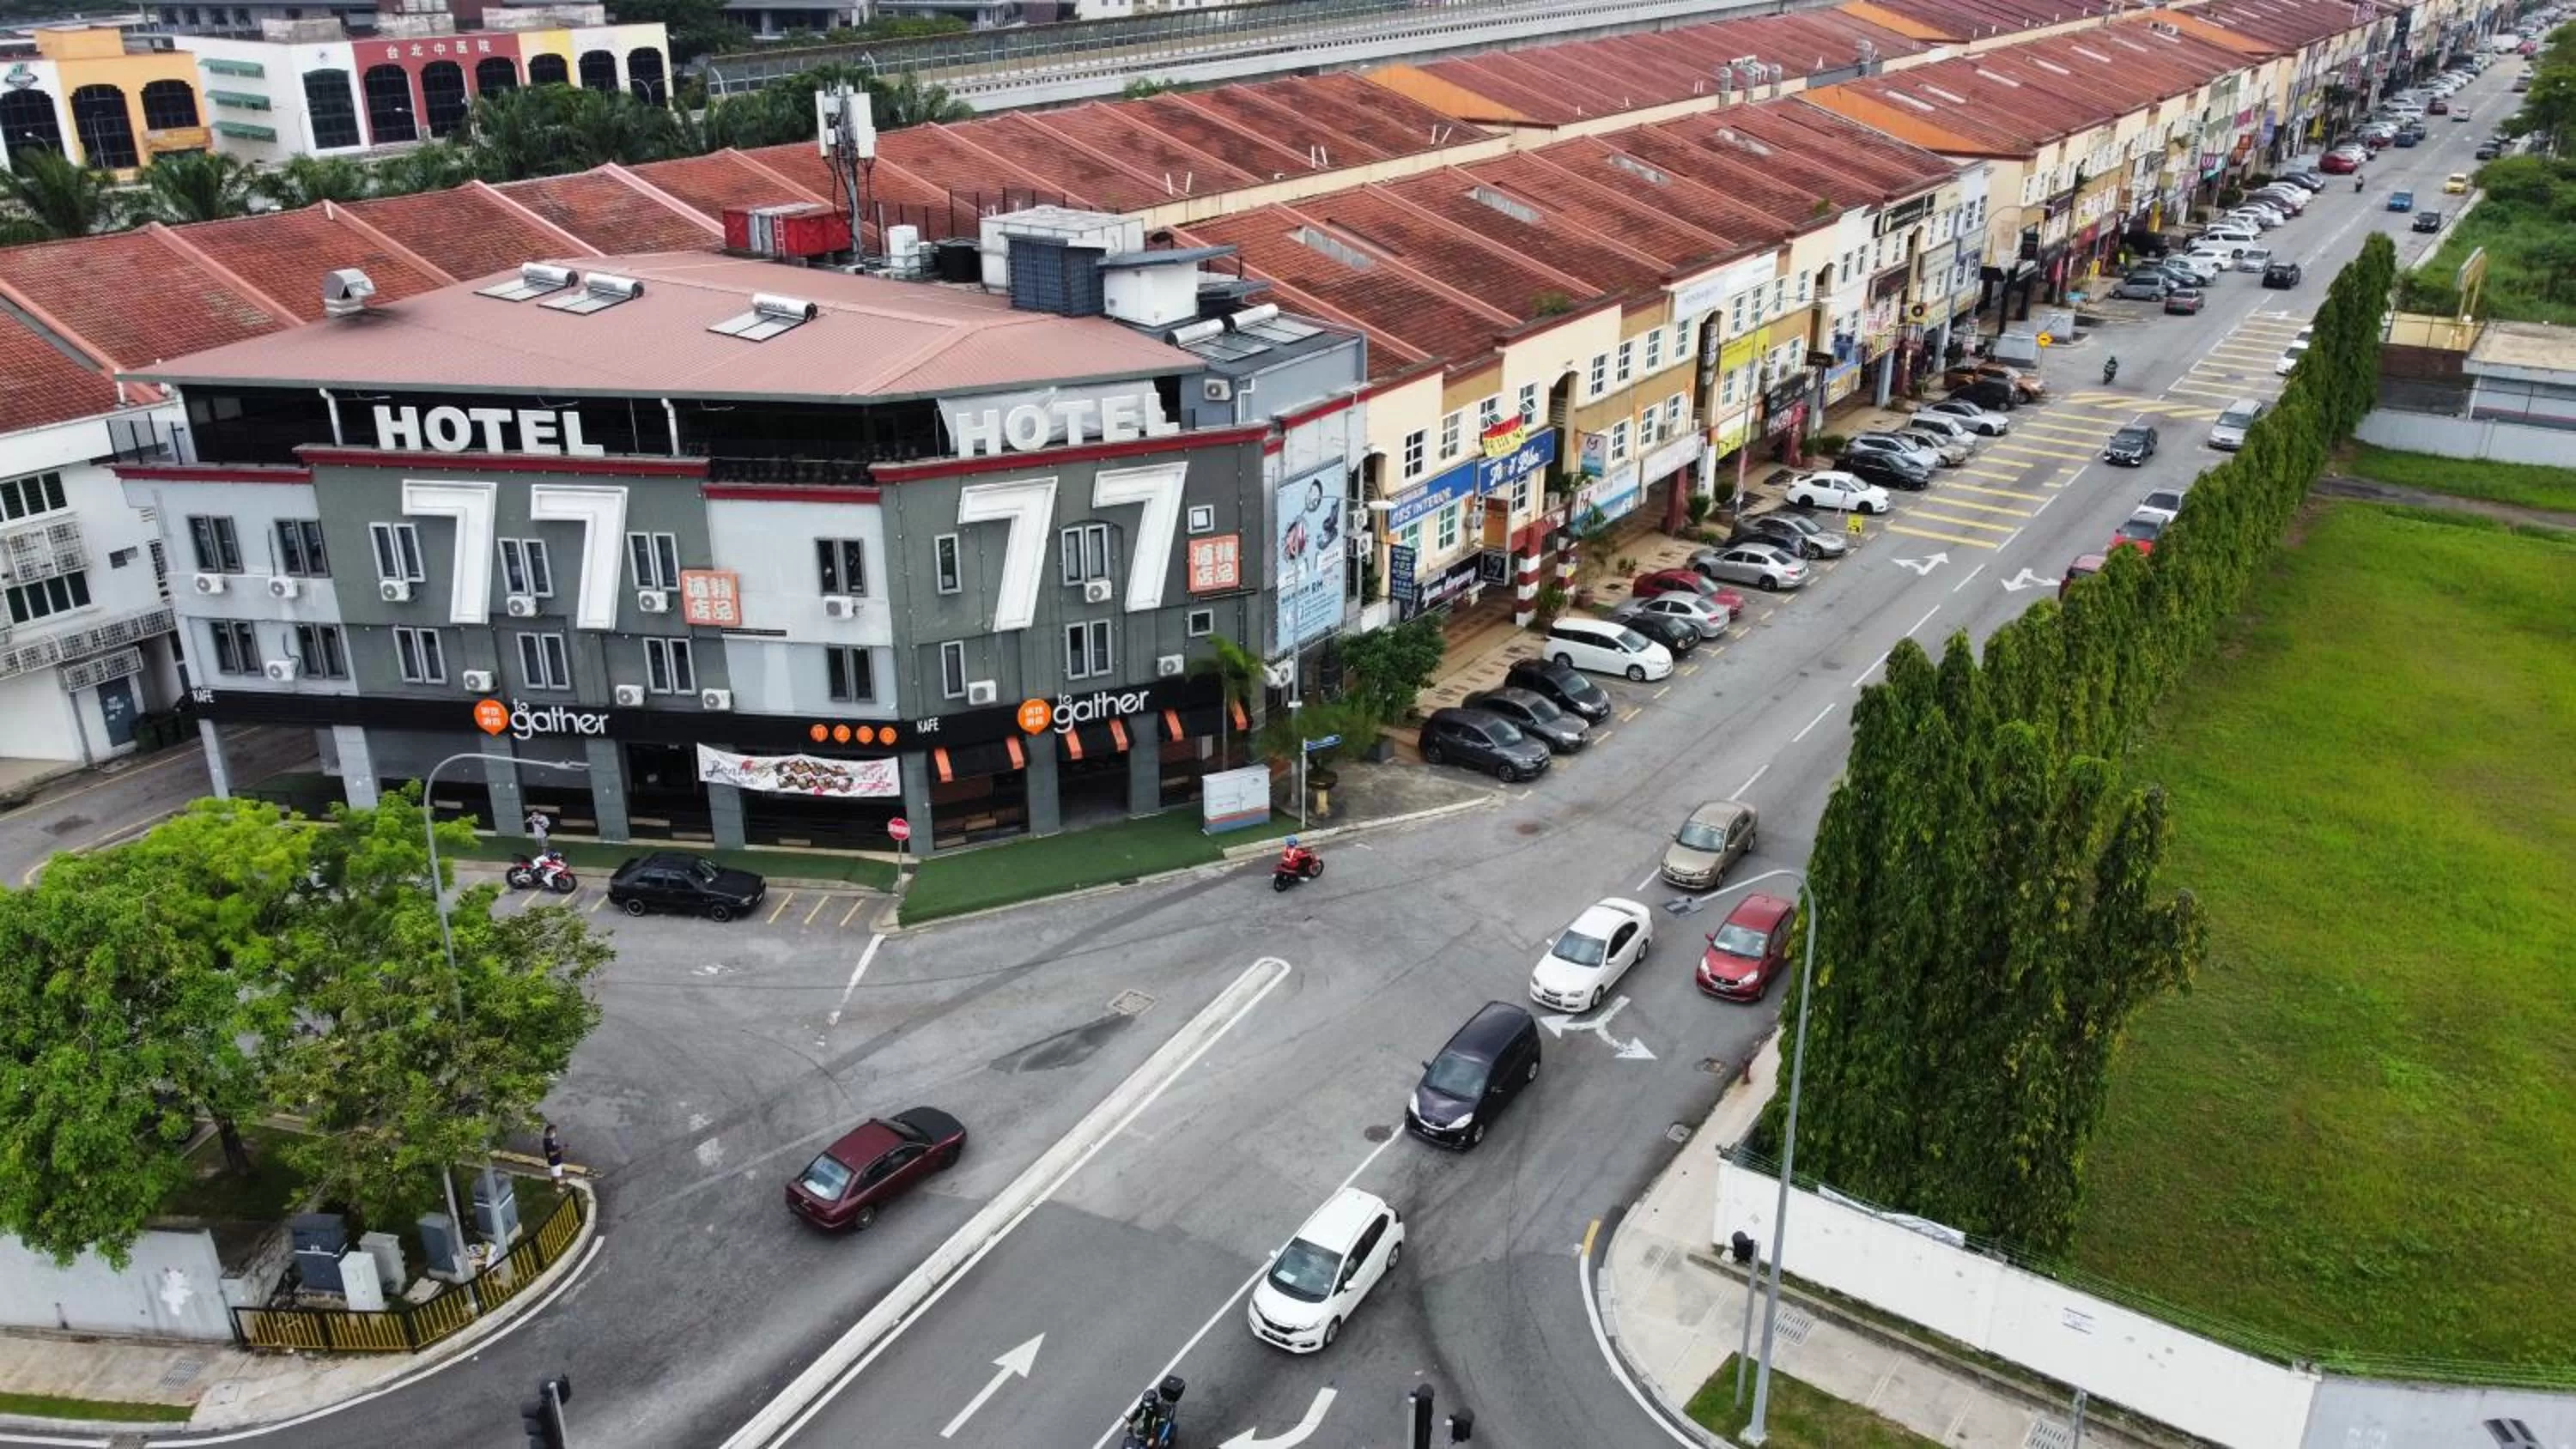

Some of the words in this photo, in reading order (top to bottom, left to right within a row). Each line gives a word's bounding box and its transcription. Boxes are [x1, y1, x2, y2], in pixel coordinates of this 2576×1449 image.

[374, 404, 605, 457] HOTEL
[956, 392, 1180, 458] HOTEL
[402, 479, 629, 630] 77
[958, 461, 1188, 633] 77
[192, 689, 215, 703] KAFE
[513, 698, 529, 712] to
[1052, 690, 1150, 734] gather
[1057, 693, 1072, 706] to
[510, 706, 609, 740] gather
[916, 717, 940, 733] KAFE
